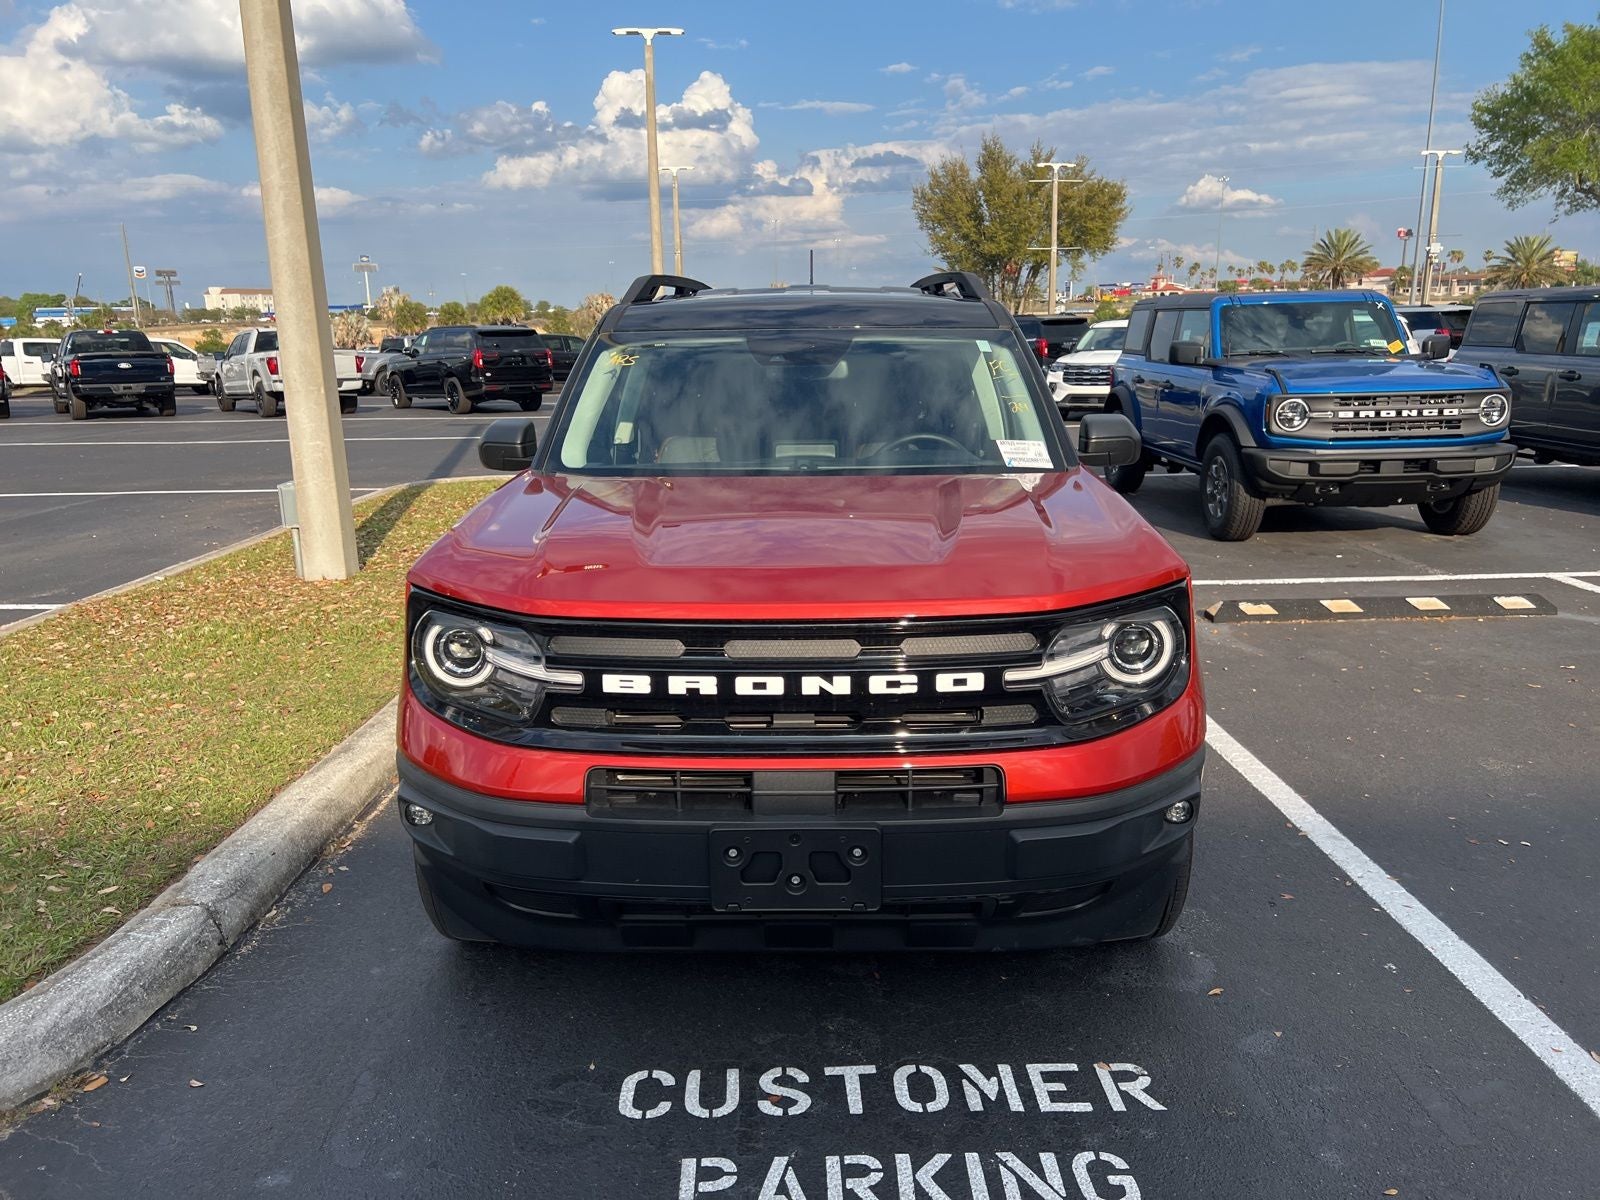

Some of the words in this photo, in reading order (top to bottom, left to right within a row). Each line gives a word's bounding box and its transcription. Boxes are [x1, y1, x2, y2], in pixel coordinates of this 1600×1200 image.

[1338, 408, 1459, 418] BRONCO
[601, 671, 985, 696] BRONCO
[618, 1062, 1167, 1120] CUSTOMER
[678, 1151, 1142, 1200] PARKING
